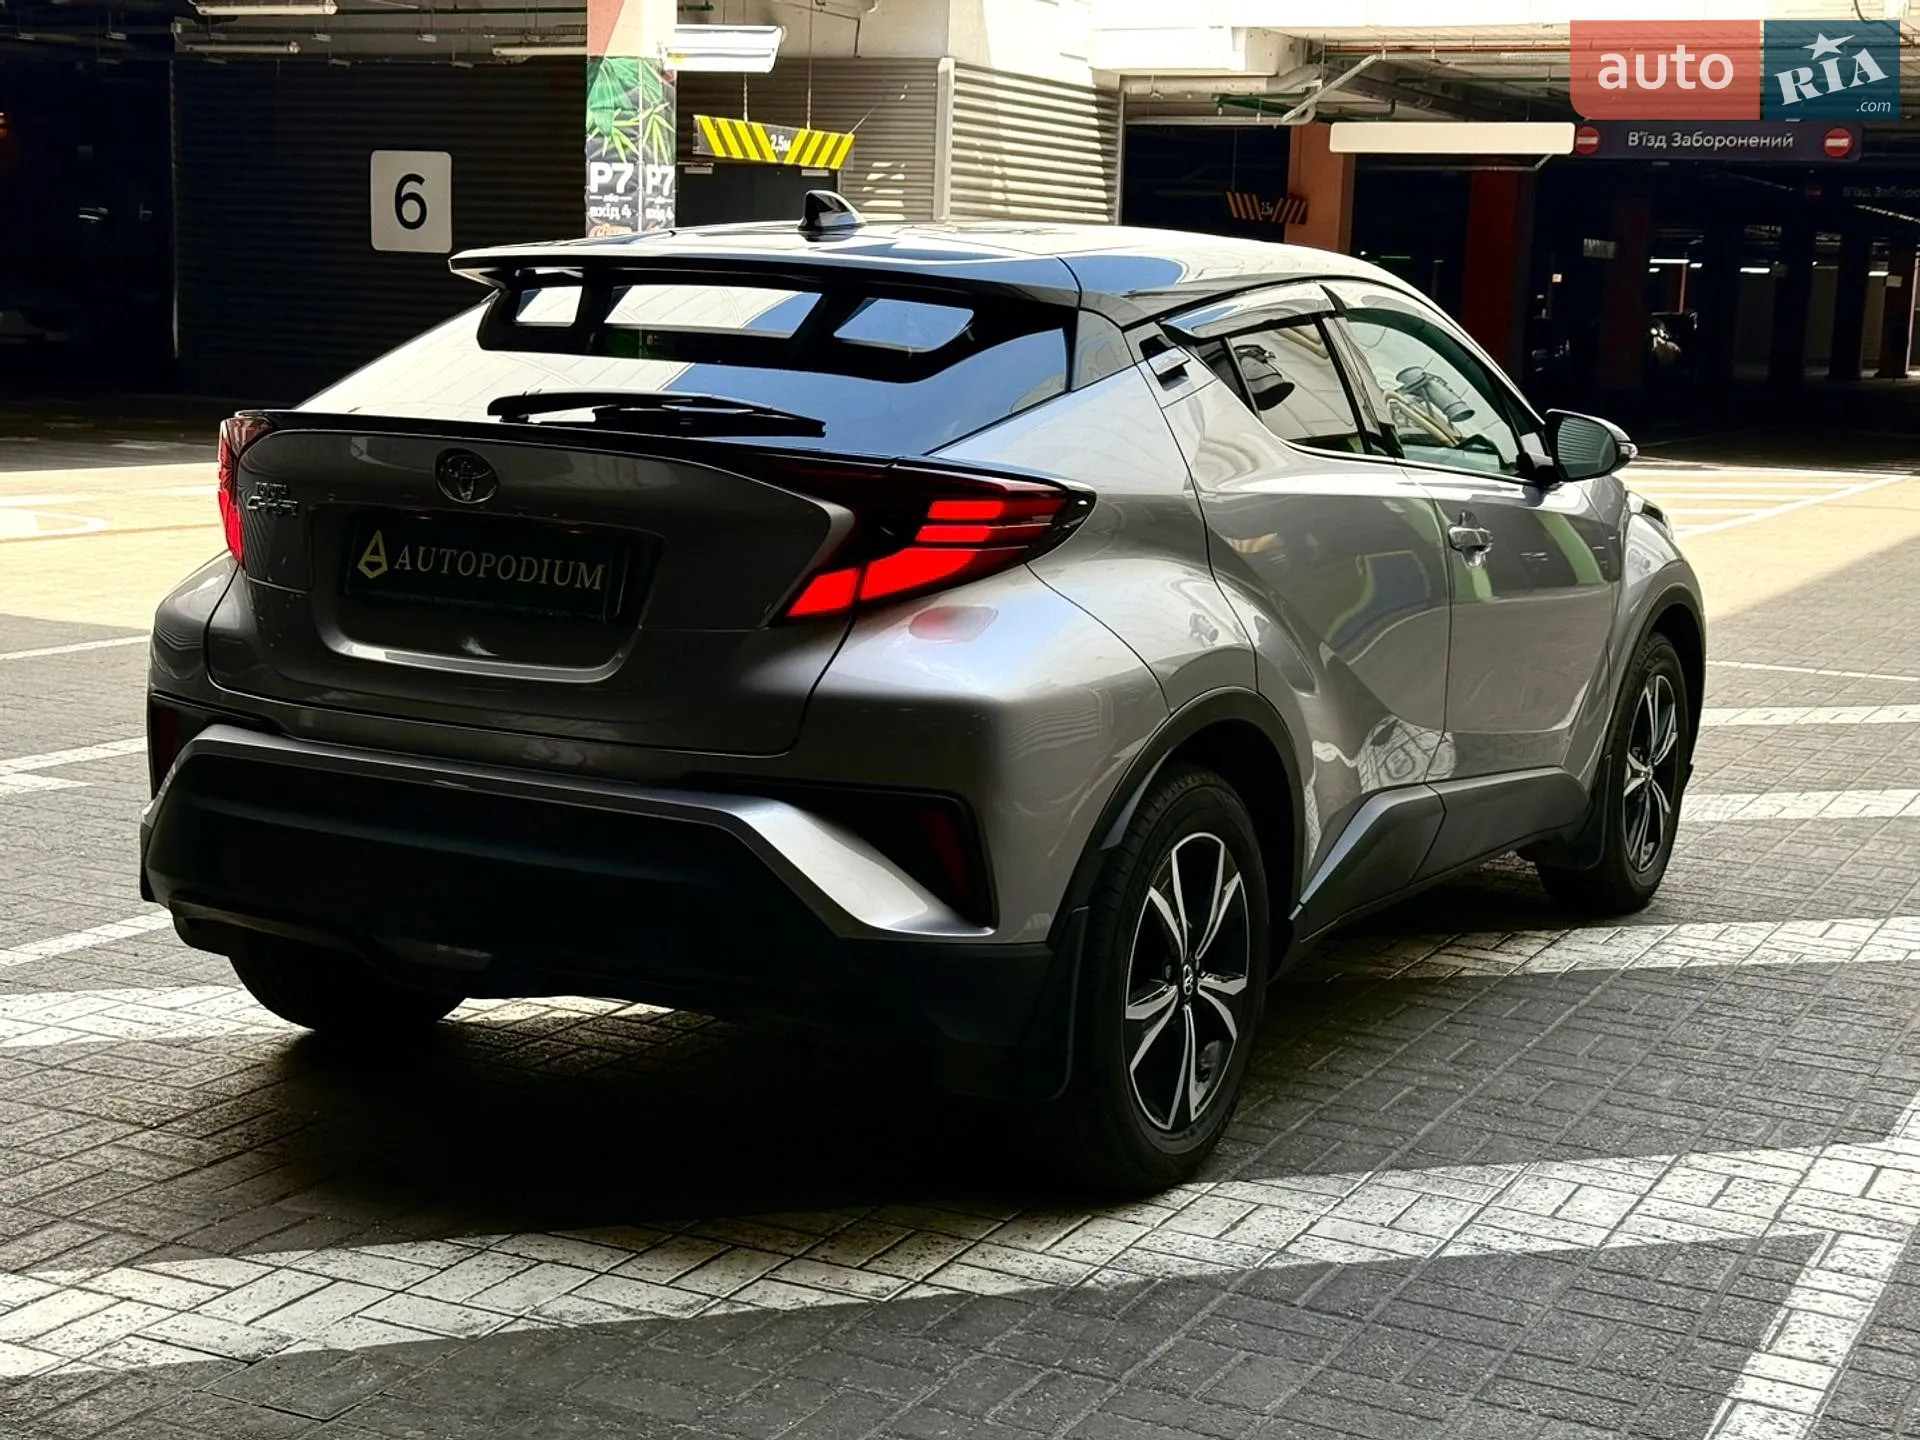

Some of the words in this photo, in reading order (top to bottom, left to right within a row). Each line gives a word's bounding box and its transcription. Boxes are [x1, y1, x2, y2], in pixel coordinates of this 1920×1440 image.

[1671, 129, 1794, 151] Заборонений
[589, 161, 634, 194] P7
[645, 164, 675, 196] P7
[395, 173, 427, 230] 6
[394, 546, 605, 591] AUTOPODIUM
